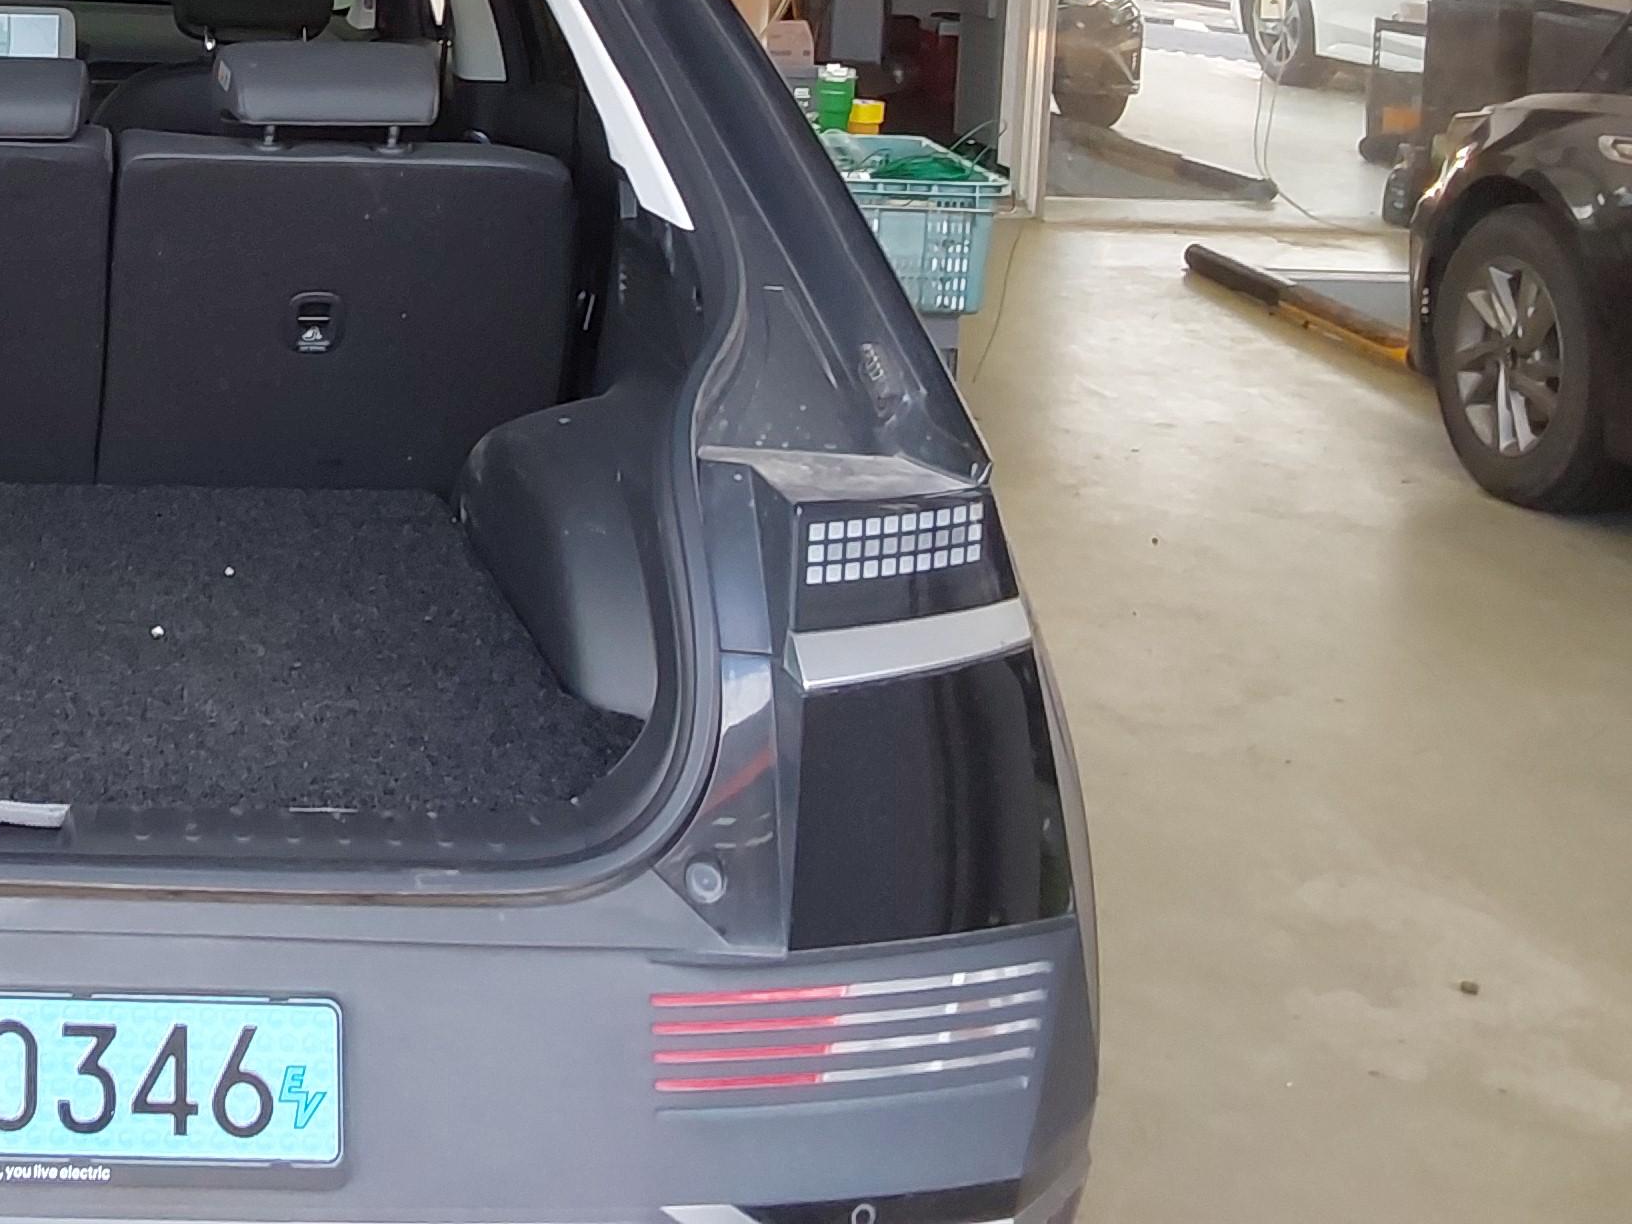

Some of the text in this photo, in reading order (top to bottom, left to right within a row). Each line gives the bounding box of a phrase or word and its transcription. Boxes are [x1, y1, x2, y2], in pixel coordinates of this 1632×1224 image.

[279, 1065, 327, 1129] EV
[5, 1165, 33, 1182] you
[34, 1165, 58, 1180] live
[60, 1165, 111, 1181] electric
